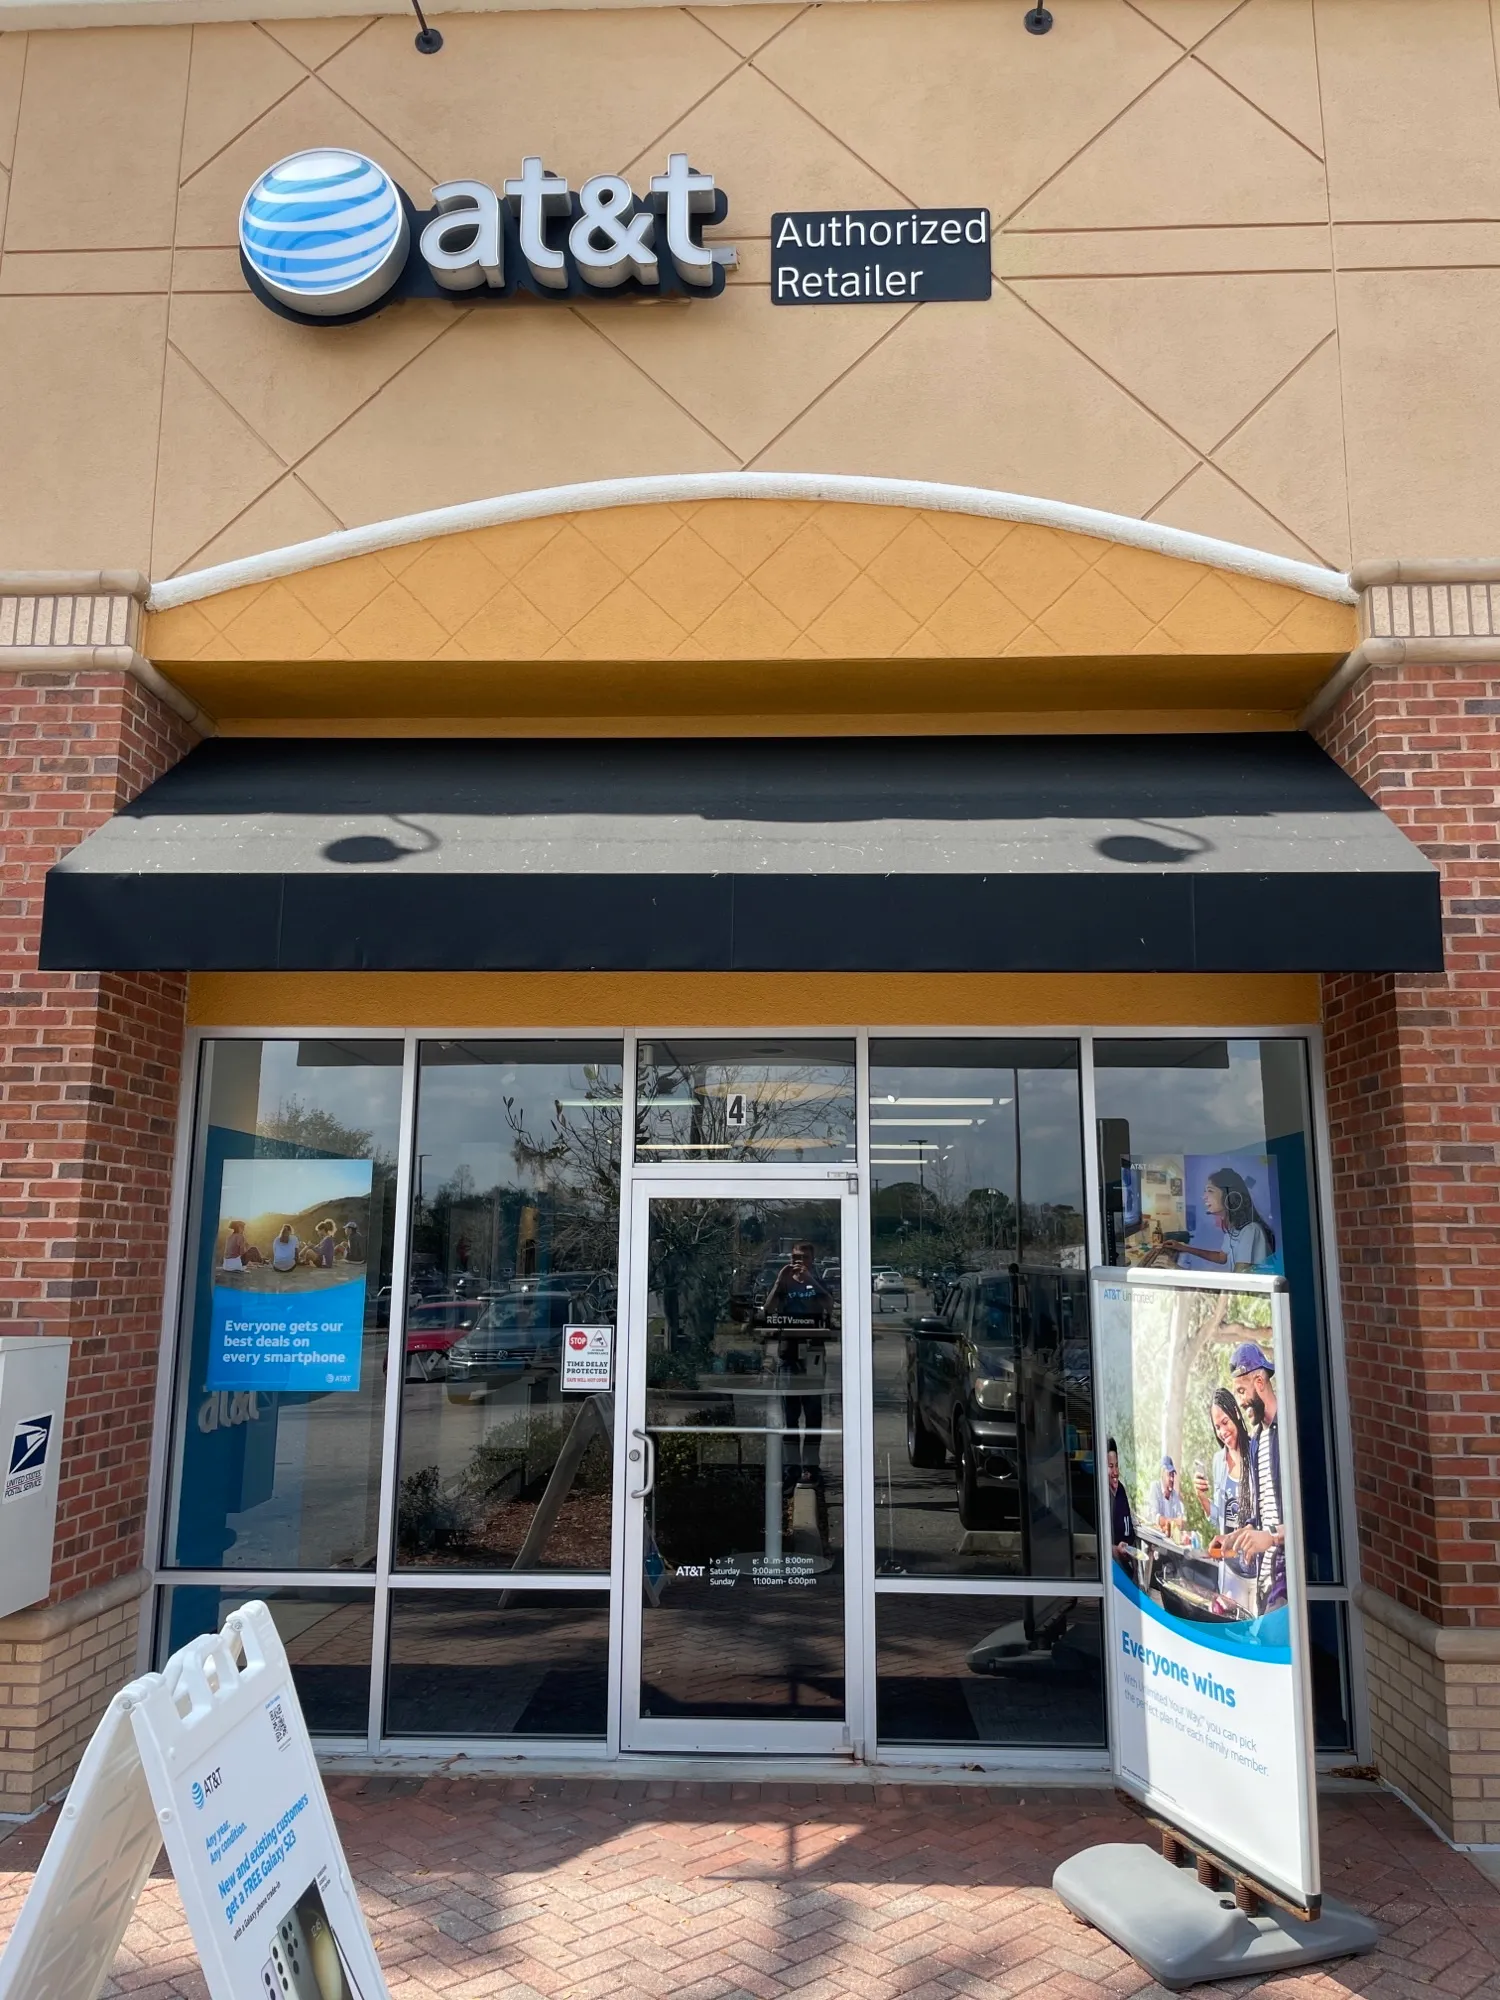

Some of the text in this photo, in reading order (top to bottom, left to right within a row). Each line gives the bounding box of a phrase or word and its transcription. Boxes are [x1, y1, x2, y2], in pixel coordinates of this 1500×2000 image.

[420, 153, 716, 276] at&t
[776, 211, 988, 250] Authorized
[777, 264, 924, 298] Retailer
[729, 1095, 744, 1124] 4
[1104, 1288, 1120, 1300] AT&T
[224, 1320, 343, 1335] Everyone gets our
[224, 1335, 310, 1348] best deals on
[222, 1351, 346, 1366] every smartphone
[7, 1475, 25, 1487] UNITED
[676, 1566, 706, 1577] AT&T
[710, 1568, 740, 1576] Saturday
[710, 1578, 736, 1587] Sunday
[788, 1578, 817, 1586] 6:00pm
[1122, 1630, 1236, 1708] Everyone wins
[1124, 1672, 1138, 1688] With
[1168, 1697, 1184, 1716] Your
[1206, 1720, 1222, 1736] you
[1222, 1728, 1238, 1744] can
[1240, 1735, 1257, 1752] pick
[1124, 1689, 1136, 1704] the
[1160, 1708, 1174, 1727] plan
[1175, 1717, 1185, 1733] for
[1187, 1728, 1204, 1744] each
[1206, 1734, 1229, 1760] family
[1230, 1750, 1269, 1776] member.
[204, 1767, 223, 1798] AT&T
[206, 1820, 230, 1850] Any year.
[210, 1822, 248, 1866] Any condition.
[218, 1793, 309, 1900] New and existing customers
[225, 1894, 240, 1926] get
[243, 1870, 262, 1899] FREE
[260, 1845, 286, 1876] Galaxy
[283, 1828, 297, 1852] S23
[233, 1926, 242, 1942] with
[244, 1908, 258, 1930] Galaxy
[256, 1896, 268, 1918] phone
[266, 1880, 282, 1900] trade-in
